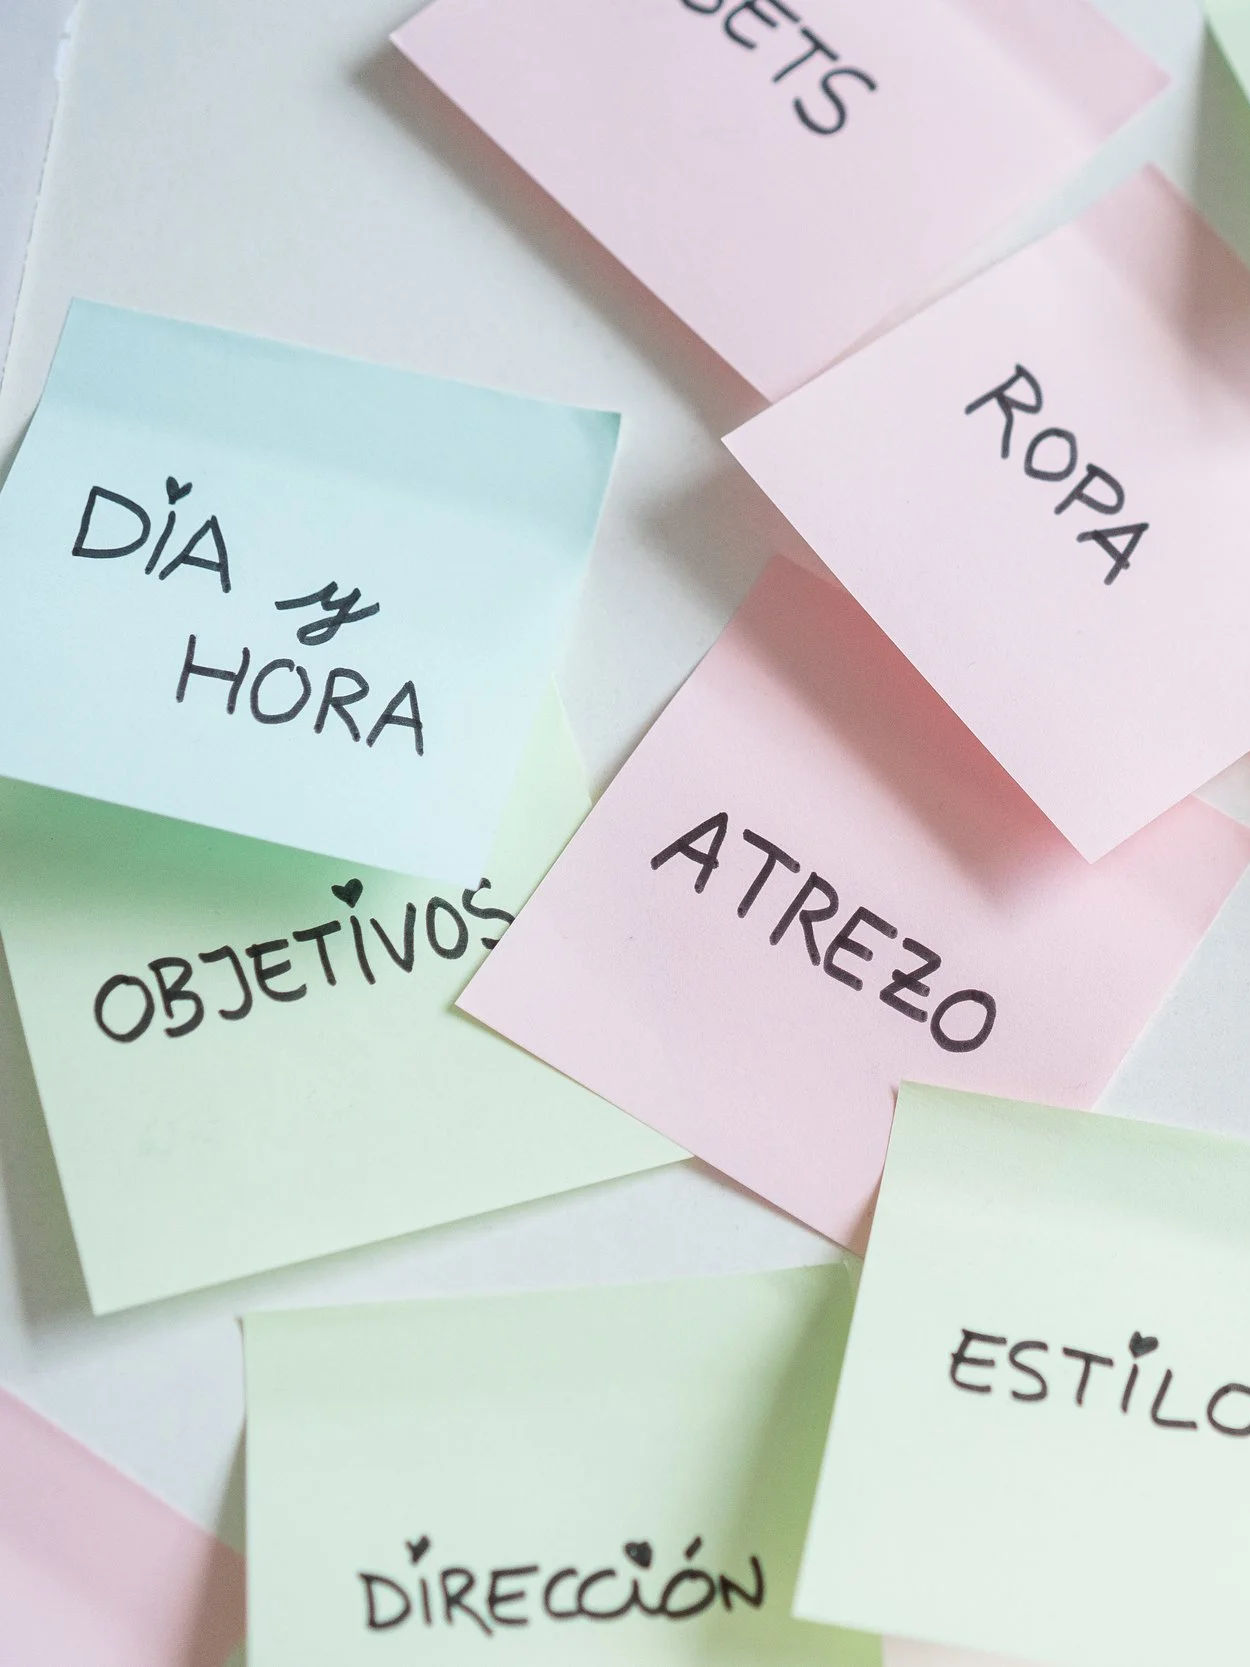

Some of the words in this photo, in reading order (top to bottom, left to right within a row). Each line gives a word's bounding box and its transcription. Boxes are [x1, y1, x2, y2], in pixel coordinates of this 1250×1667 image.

[681, 0, 878, 136] ETS
[964, 364, 1150, 586] ROPA
[274, 581, 380, 646] y
[175, 634, 424, 756] HORA
[650, 811, 997, 1053] ATREZO
